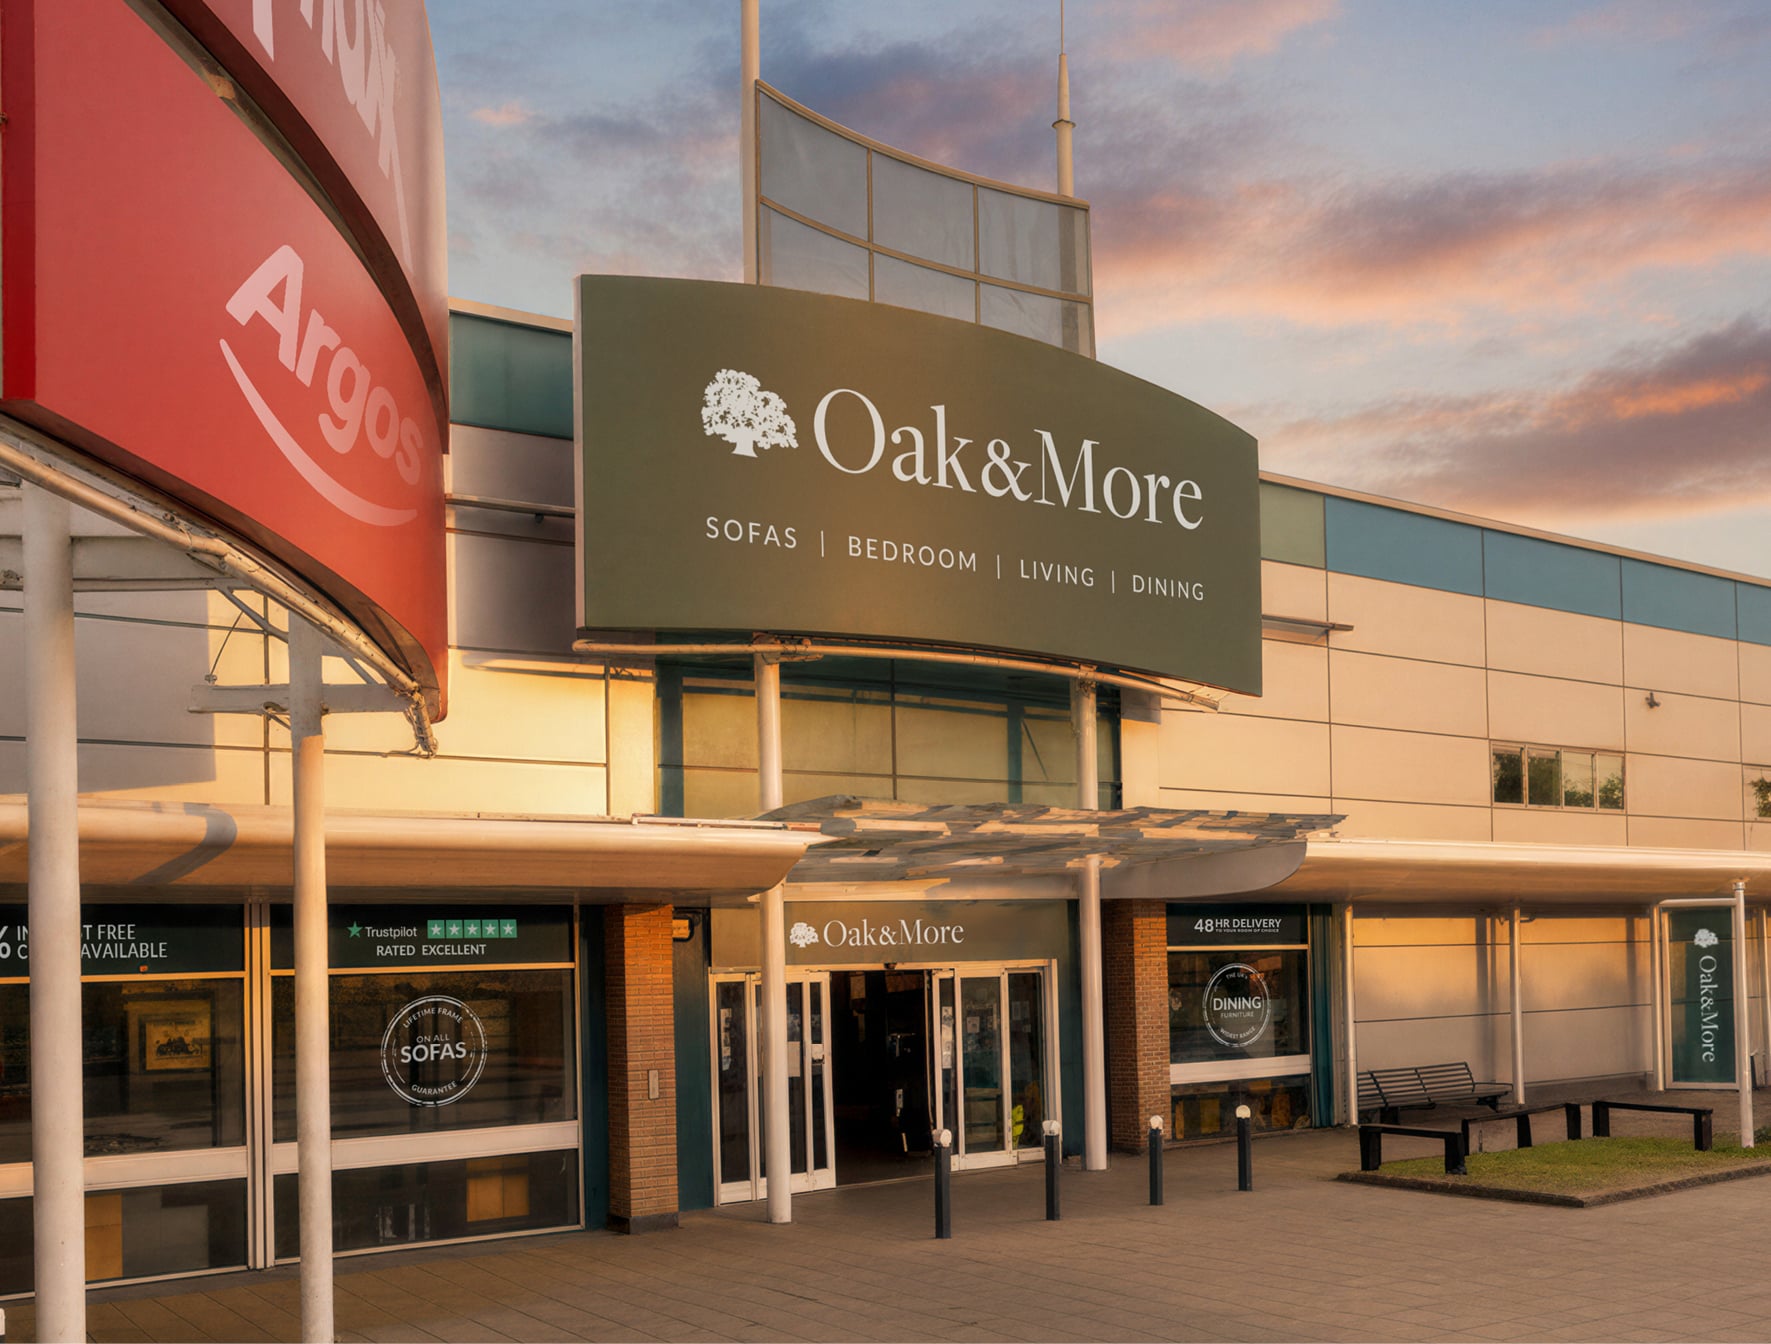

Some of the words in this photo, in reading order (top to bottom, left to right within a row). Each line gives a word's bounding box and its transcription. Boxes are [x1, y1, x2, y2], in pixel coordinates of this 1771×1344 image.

[226, 244, 424, 486] Argos
[813, 388, 1204, 530] Oak&More
[705, 516, 798, 549] SOFAS
[848, 535, 977, 572] BEDROOM
[1020, 559, 1094, 586] LIVING
[1132, 574, 1204, 600] DINING
[97, 924, 136, 940] FREE
[365, 926, 418, 939] Trustpilot
[823, 918, 965, 948] Oak&More
[1194, 918, 1214, 933] 48
[1215, 918, 1230, 928] HR
[1232, 918, 1282, 928] DELIVERY
[81, 942, 168, 959] AVAILABLE
[376, 945, 416, 957] RATED
[421, 944, 487, 956] EXCELLENT
[1213, 996, 1262, 1011] DINING
[1699, 955, 1719, 1063] Oak&More
[403, 1007, 436, 1029] LIFETIME
[437, 1007, 464, 1024] FRAME
[1221, 1011, 1254, 1019] FURNITURE
[416, 1035, 431, 1043] ON
[433, 1033, 450, 1042] ALL
[400, 1041, 467, 1064] SOFAS
[411, 1080, 458, 1096] GUARANTEE
